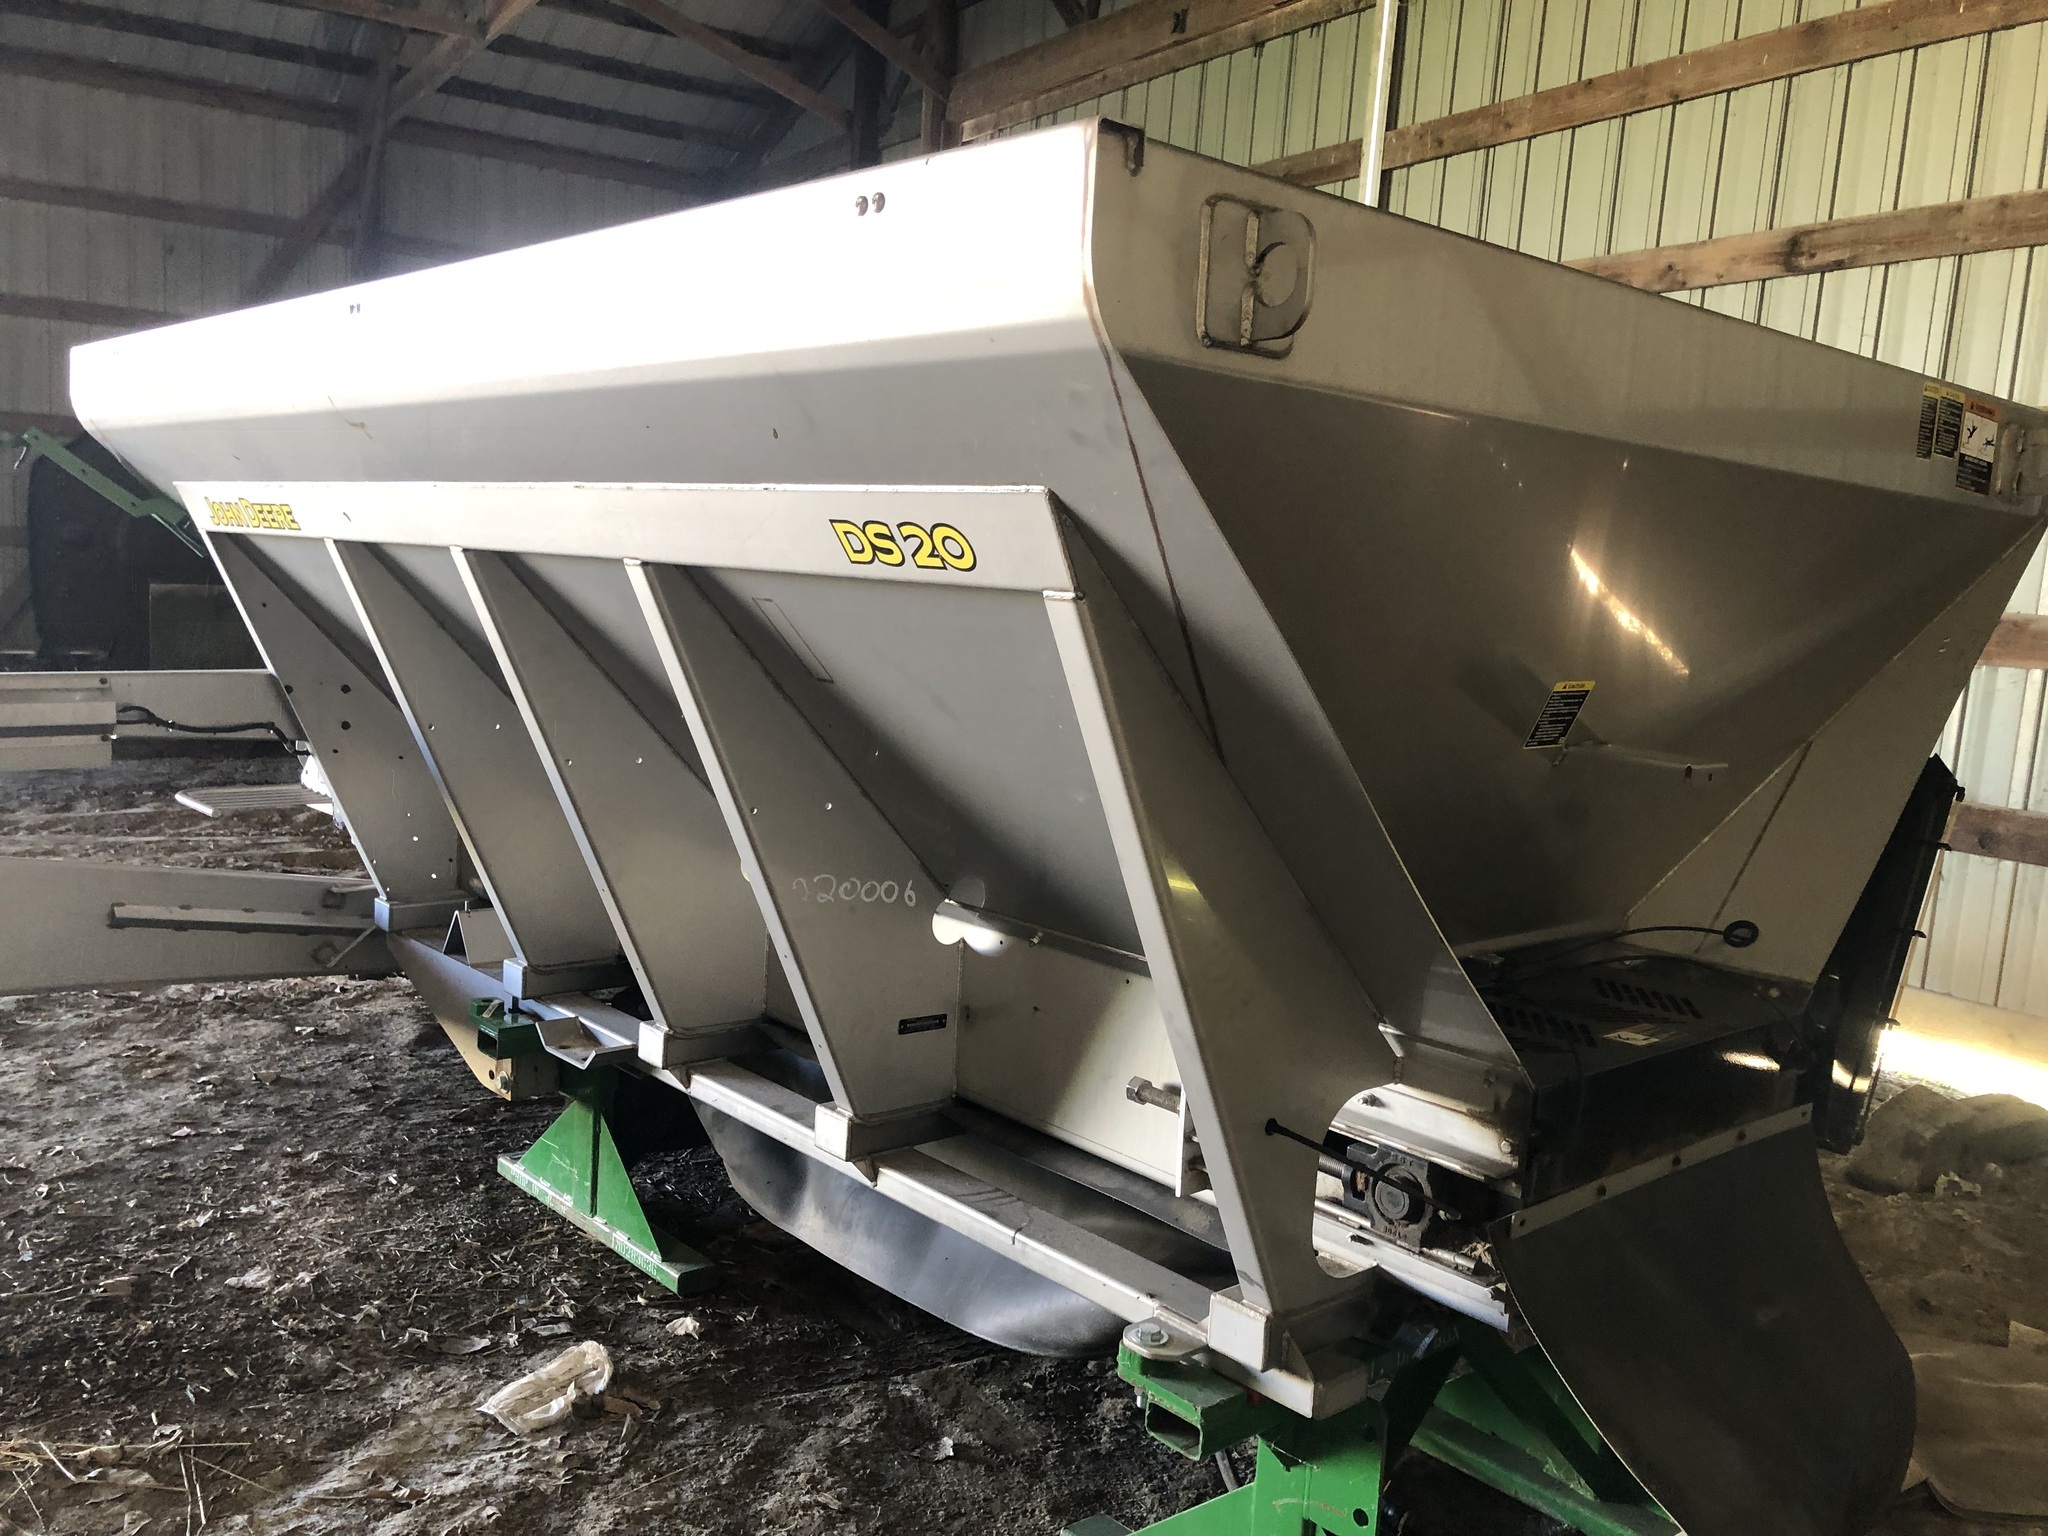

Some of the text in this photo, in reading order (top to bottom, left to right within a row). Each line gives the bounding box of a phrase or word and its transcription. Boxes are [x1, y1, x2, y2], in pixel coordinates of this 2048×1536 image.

[204, 496, 302, 531] JOHN DEERE
[828, 519, 977, 572] DS20
